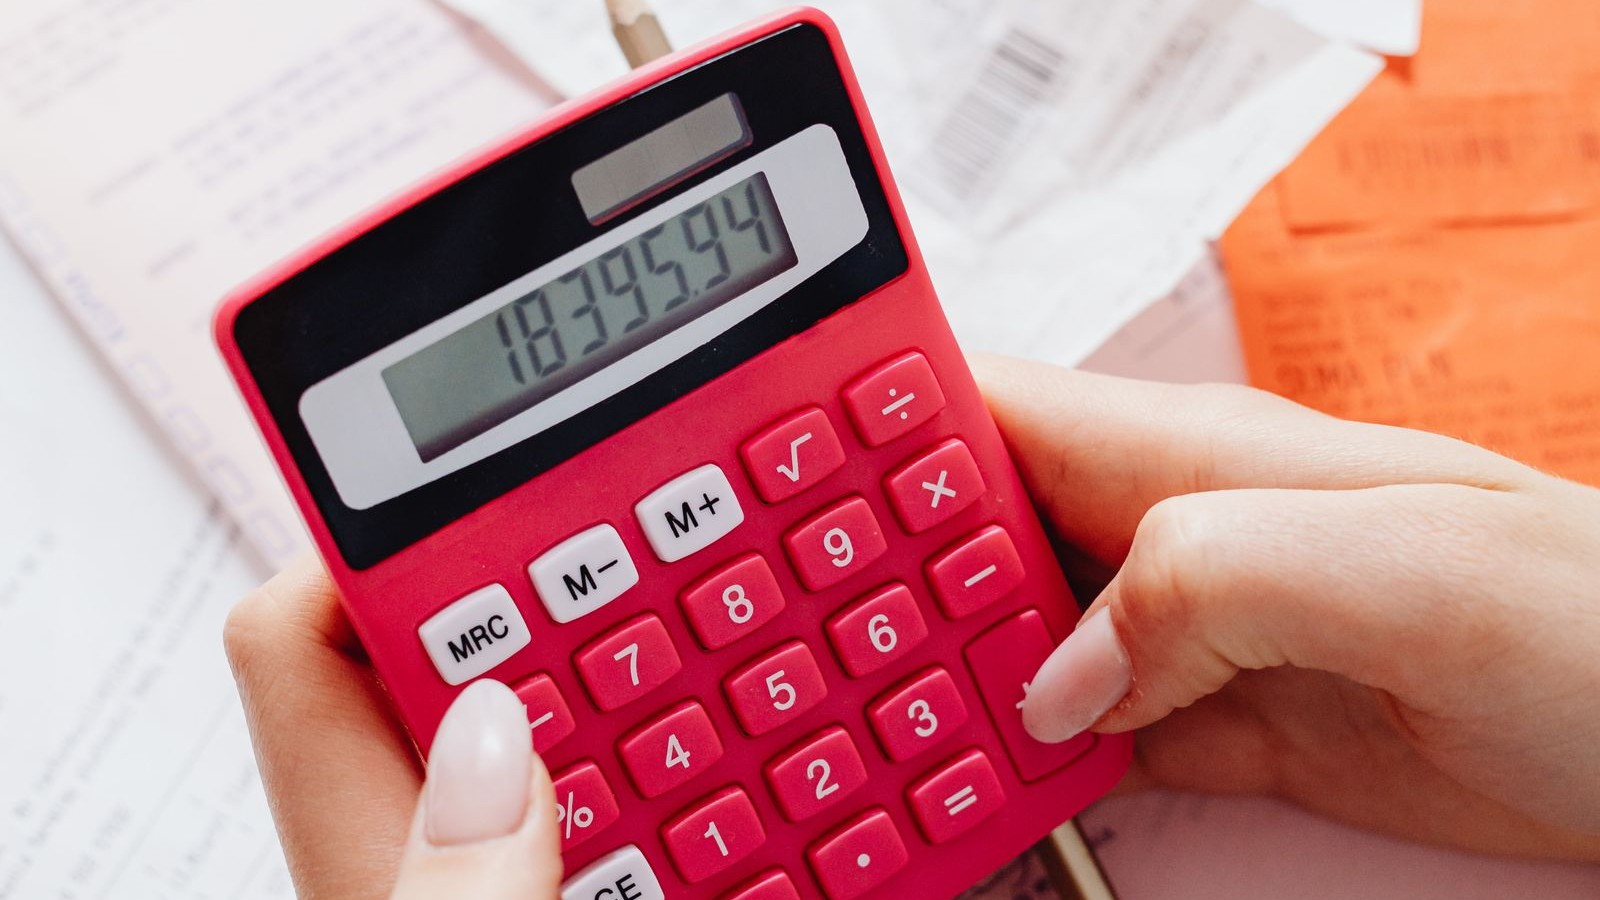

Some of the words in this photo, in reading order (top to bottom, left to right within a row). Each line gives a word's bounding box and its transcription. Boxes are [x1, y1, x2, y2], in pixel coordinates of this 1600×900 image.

[496, 182, 772, 386] 18395.94
[664, 492, 720, 539] M+
[823, 527, 854, 568] 9
[562, 559, 618, 601] M-
[722, 584, 754, 624] 8
[447, 614, 509, 663] MRC
[867, 614, 898, 653] 6
[613, 643, 640, 686] 7
[765, 669, 796, 711] 5
[907, 699, 938, 737] 3
[665, 734, 691, 769] 4
[806, 758, 839, 800] 2
[703, 821, 729, 857] 1
